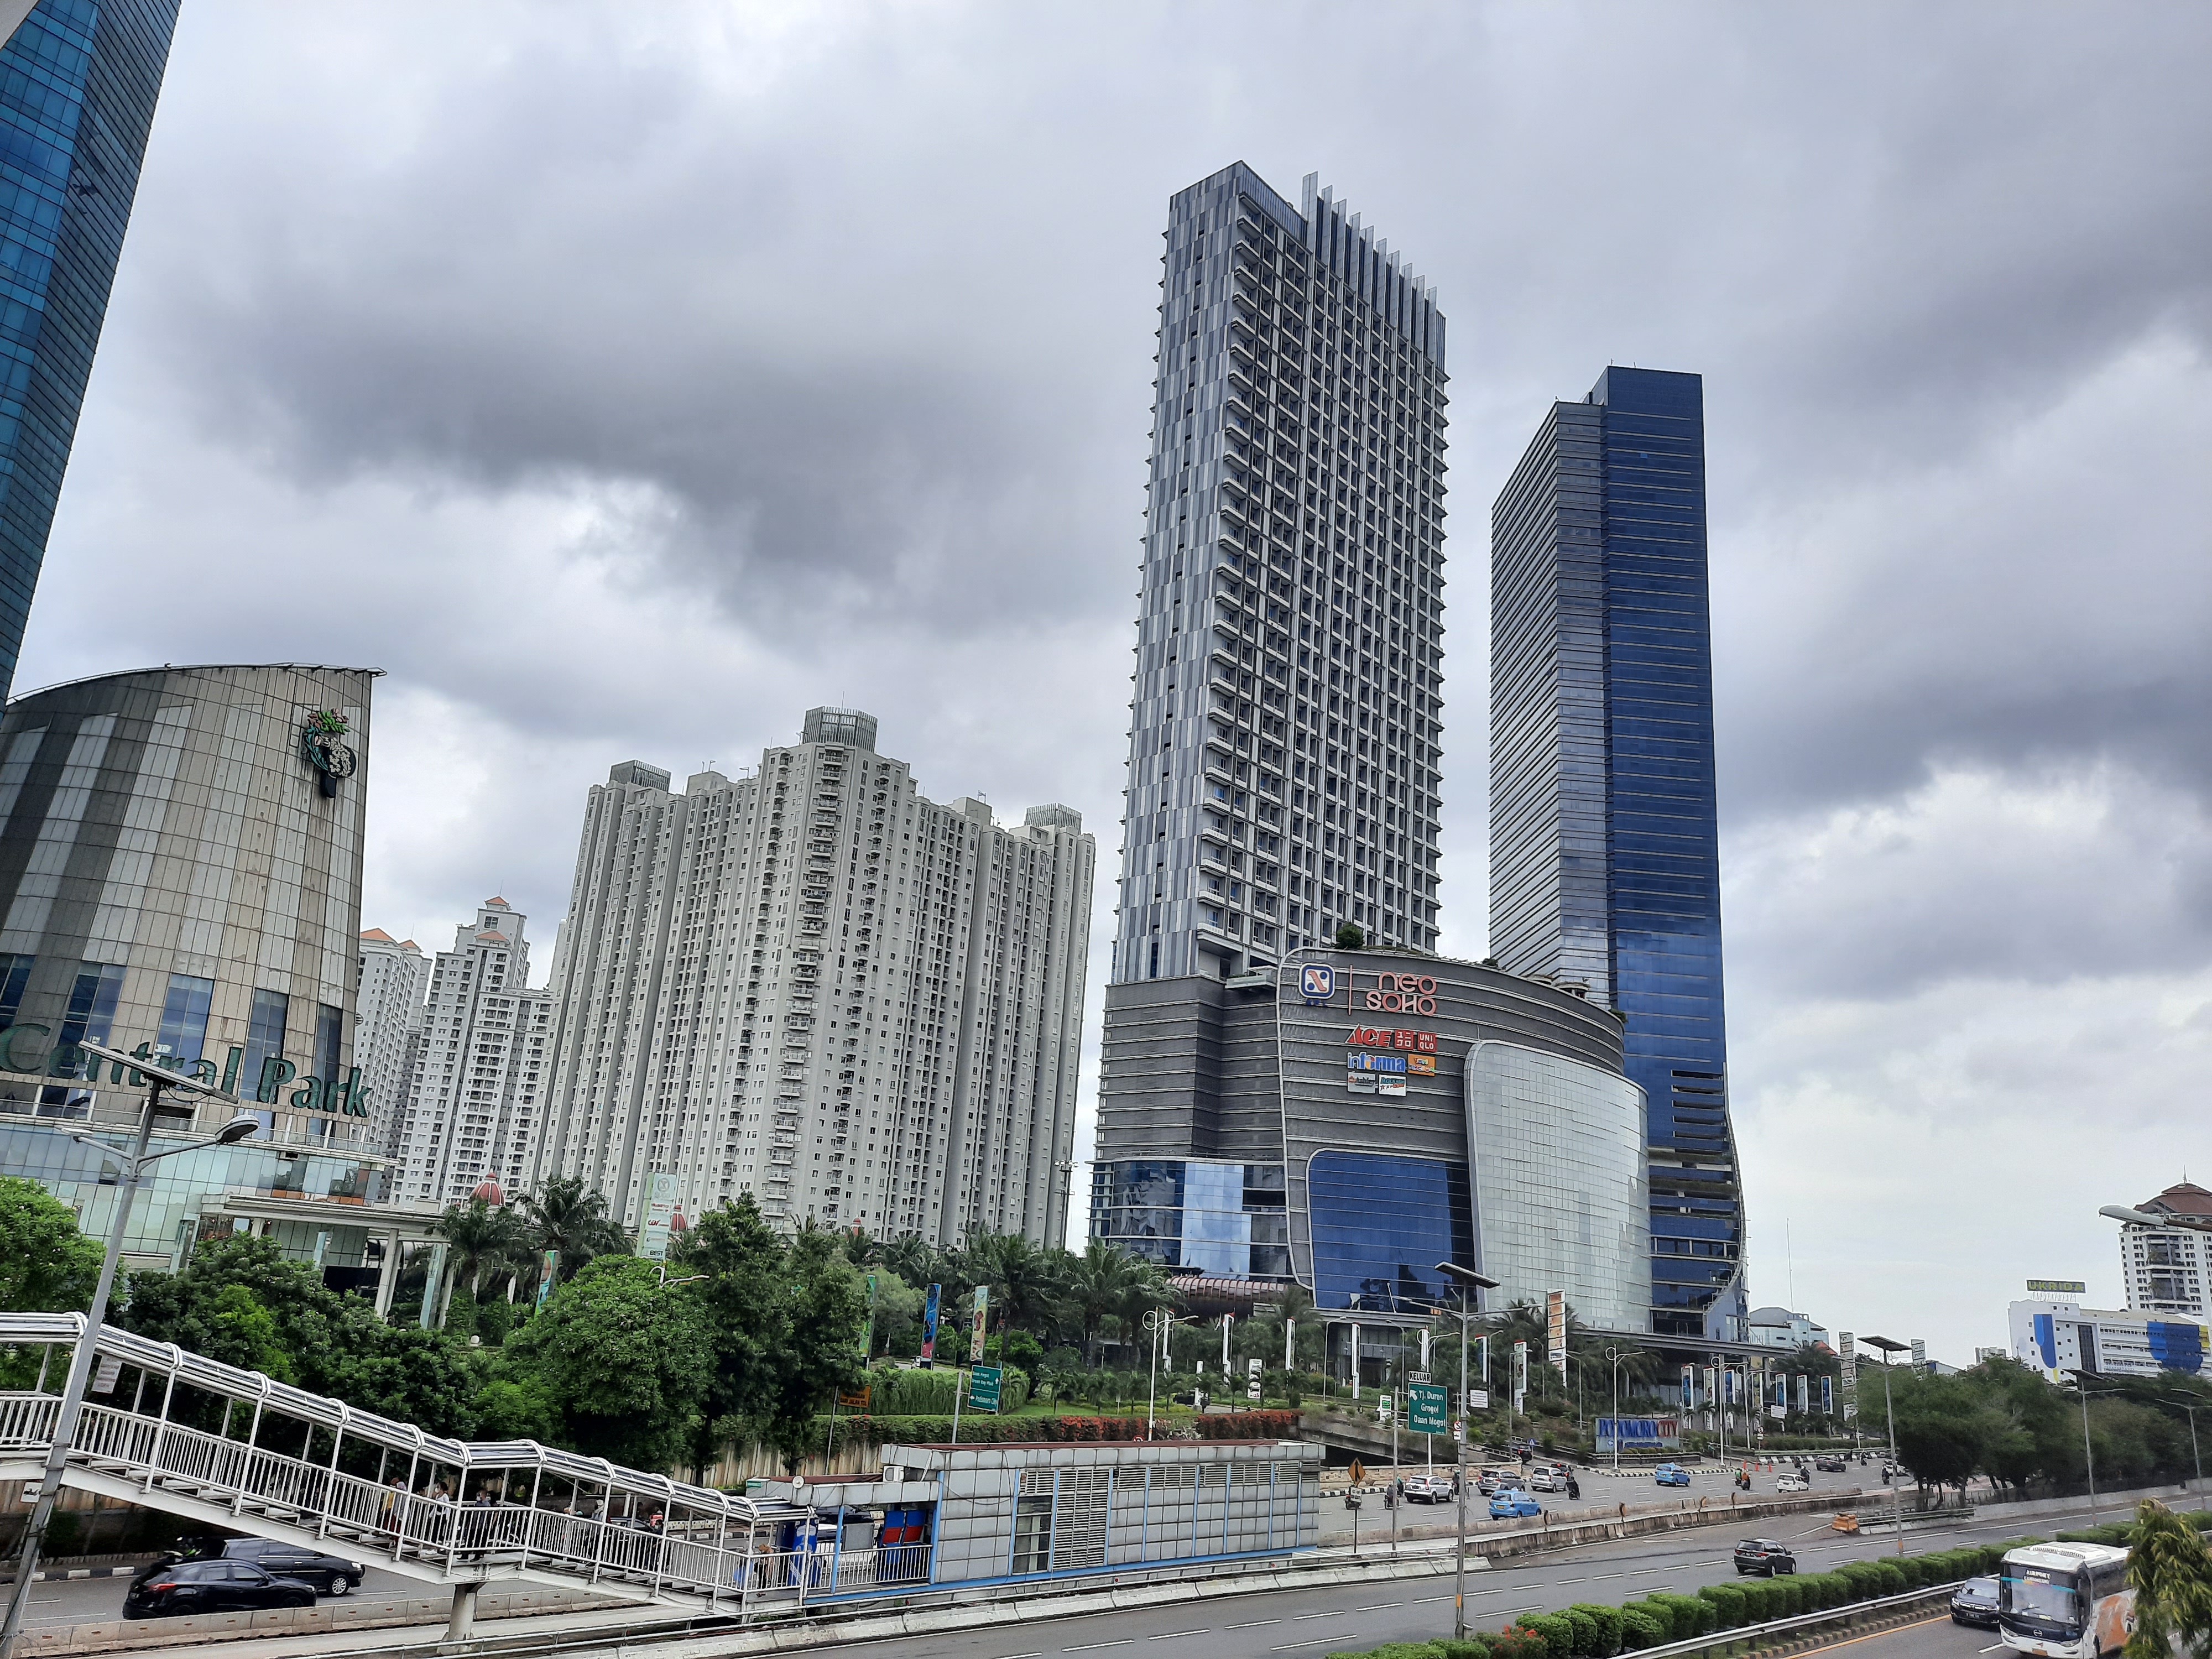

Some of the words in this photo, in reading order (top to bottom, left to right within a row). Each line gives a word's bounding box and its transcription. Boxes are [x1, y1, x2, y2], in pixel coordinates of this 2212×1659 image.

[1379, 972, 1437, 995] neo
[1366, 991, 1436, 1016] SOHO
[1345, 1023, 1391, 1047] ACE
[1420, 1034, 1433, 1042] UNI
[1420, 1041, 1434, 1050] QLO
[1347, 1052, 1406, 1073] informa
[0, 1023, 243, 1096] Central
[257, 1056, 372, 1118] Park
[2028, 1281, 2083, 1291] UKRIDA
[1410, 1372, 1430, 1381] KELUAR
[1427, 1391, 1443, 1401] Duren
[1421, 1404, 1439, 1414] Grogol
[1413, 1415, 1427, 1424] Daan
[1429, 1417, 1446, 1428] Mogot
[1657, 1420, 1678, 1438] CITY
